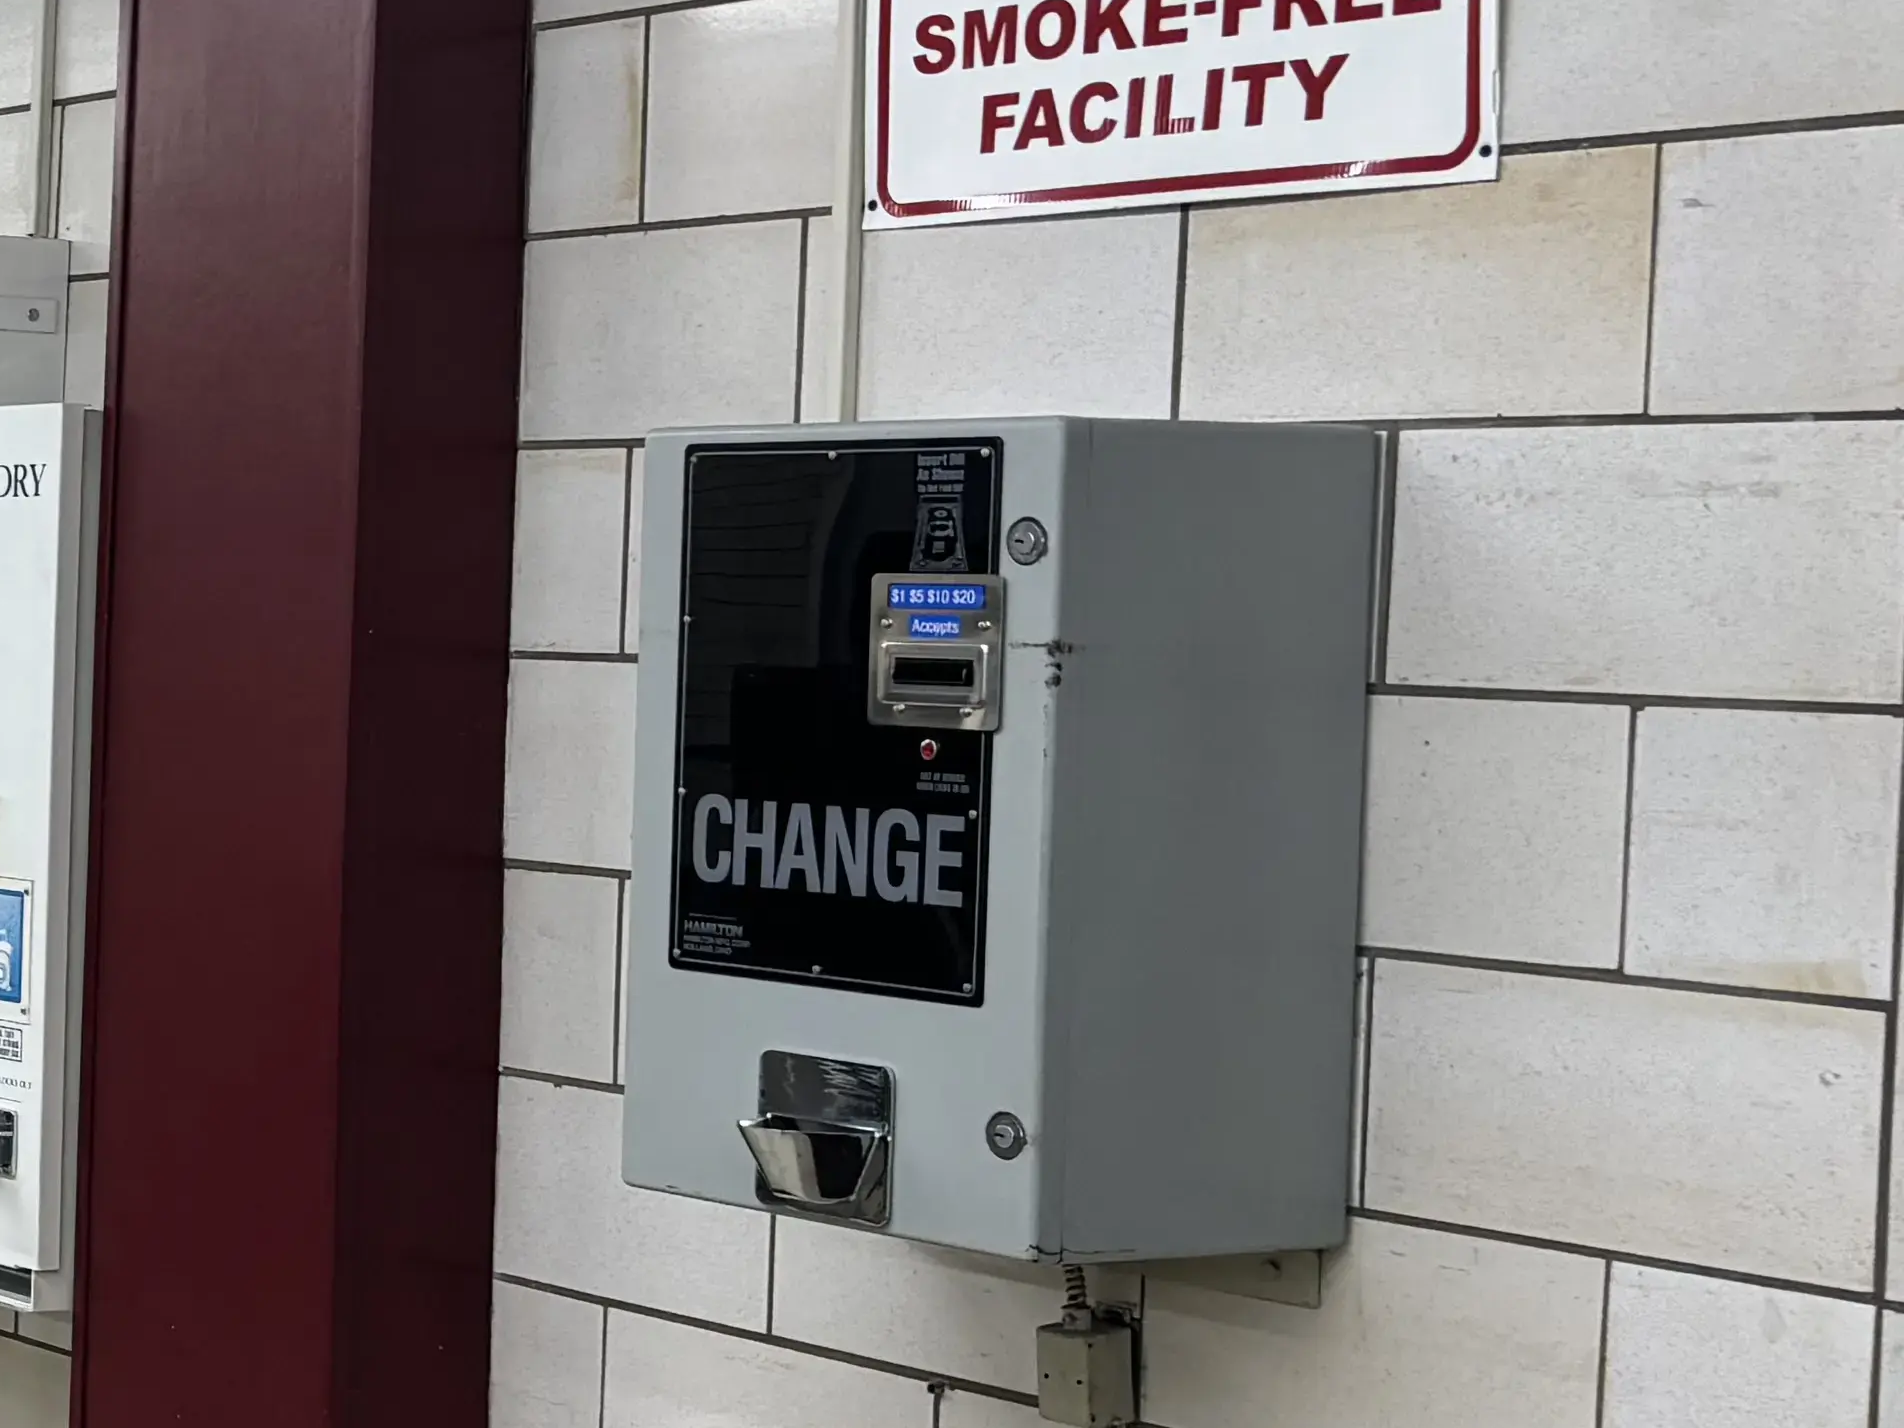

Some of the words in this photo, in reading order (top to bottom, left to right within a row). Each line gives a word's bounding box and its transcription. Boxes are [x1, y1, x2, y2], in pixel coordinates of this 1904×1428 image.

[980, 54, 1350, 153] FACILITY
[891, 589, 905, 604] $1
[910, 589, 924, 604] $5
[927, 589, 949, 605] $10
[952, 590, 975, 605] $20
[692, 793, 965, 908] CHANGE
